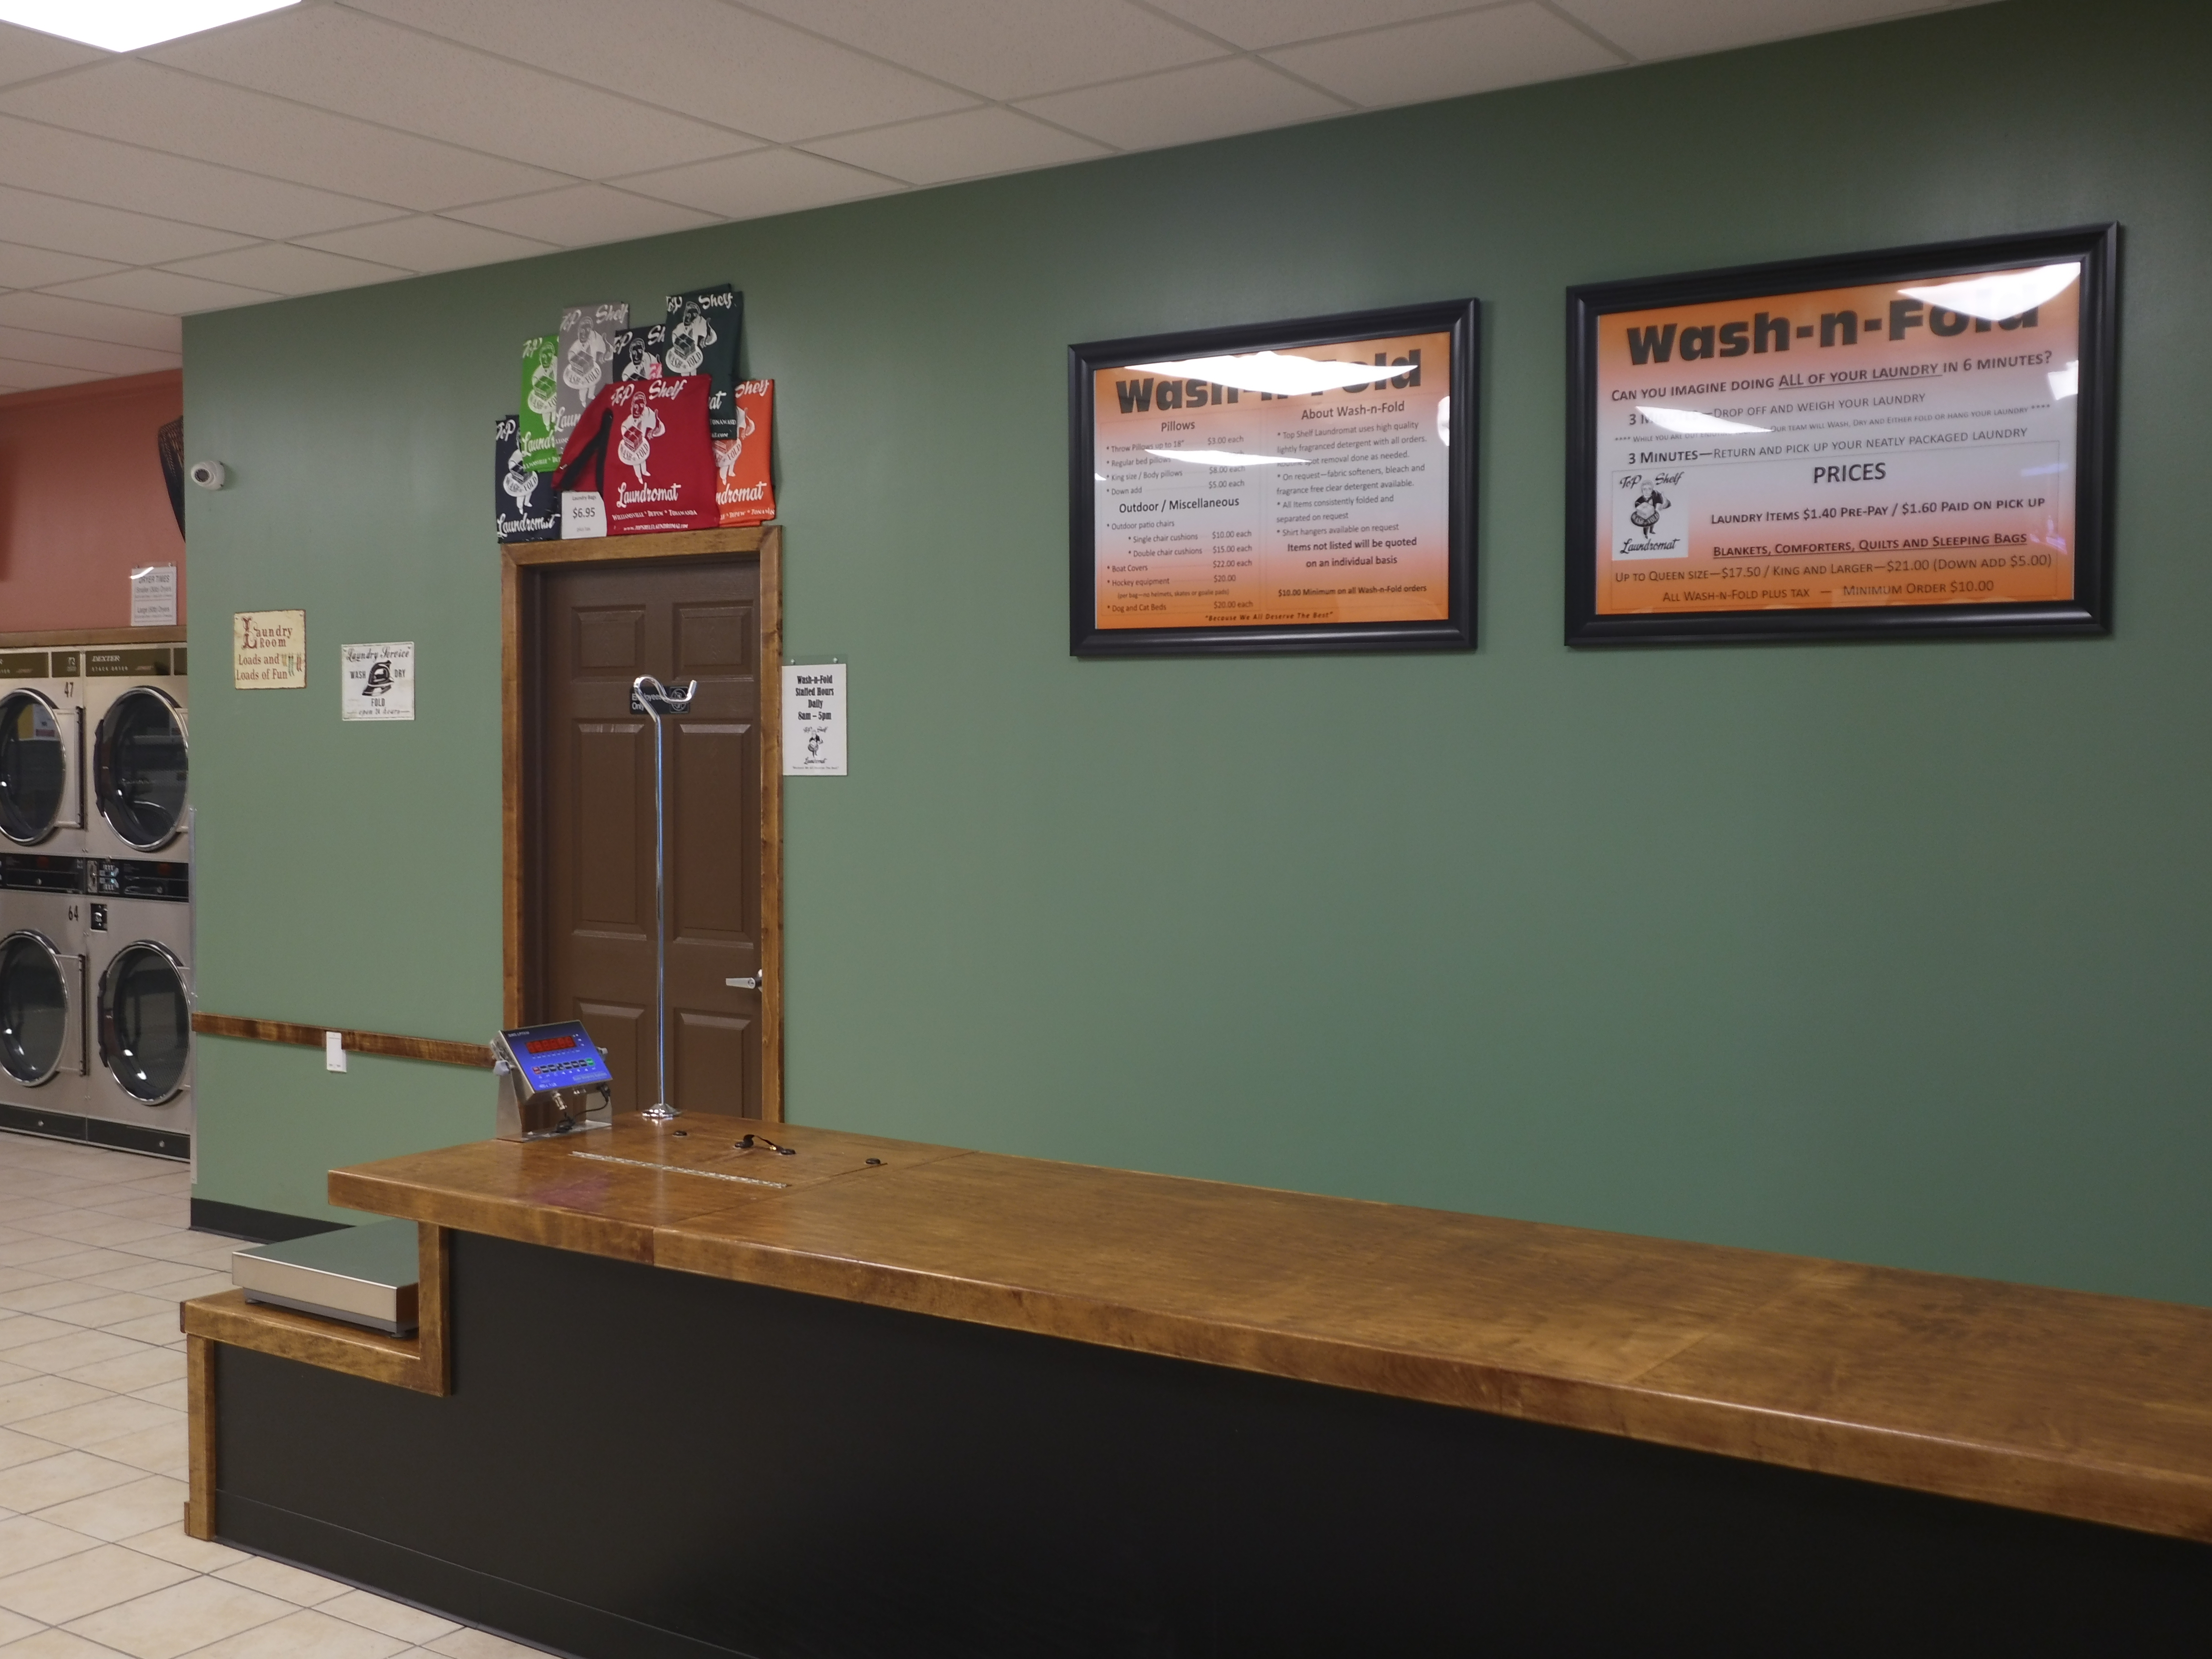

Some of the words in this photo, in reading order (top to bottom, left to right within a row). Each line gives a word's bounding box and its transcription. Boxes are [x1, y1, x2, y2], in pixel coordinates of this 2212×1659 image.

[698, 292, 733, 310] Shelf
[1612, 390, 1637, 402] CAN
[1641, 387, 1667, 399] YOU
[1671, 382, 1727, 397] IMAGINE
[1732, 378, 1775, 392] DOING
[1779, 374, 1805, 387] ALL
[1808, 373, 1825, 385] OF
[1830, 370, 1868, 382] YOUR
[1873, 364, 1940, 379] LAUNDRY
[1944, 362, 1958, 373] IN
[1964, 358, 1972, 372] 6
[1977, 351, 2052, 370] MINUTES?
[649, 379, 687, 401] Shelf
[1302, 408, 1334, 421] About
[1337, 401, 1405, 417] Wash-n-Fold
[1629, 413, 1636, 426] 3
[1748, 406, 1767, 417] OFF
[1770, 404, 1794, 415] AND
[1798, 401, 1835, 412] WEIGH
[1839, 398, 1870, 409] YOUR
[1874, 394, 1926, 407] LAUNDRY
[1161, 421, 1196, 432] Pillows
[1283, 432, 1296, 440] Top
[1297, 429, 1314, 439] Shelf
[1315, 427, 1357, 437] Laundromat
[1377, 423, 1393, 433] high
[1394, 421, 1419, 432] quality
[1132, 443, 1154, 453] Pillows
[1208, 436, 1227, 446] $3.00
[1228, 435, 1244, 444] each
[1629, 452, 1637, 465] 3
[1760, 446, 1783, 456] AND
[1787, 444, 1810, 454] PICK
[1814, 442, 1829, 452] UP
[1832, 440, 1862, 451] YOUR
[1867, 437, 1905, 448] NEATLY
[1910, 432, 1969, 445] PACKAGED
[1973, 428, 2028, 441] LAUNDRY
[1655, 472, 1685, 486] Shelf
[1814, 463, 1887, 484] PRICES
[616, 482, 681, 508] Laundromat
[573, 507, 596, 519] $6.95
[1119, 502, 1159, 514] Outdoor
[1170, 498, 1240, 510] Miscellaneous
[1712, 514, 1763, 525] LAUNDRY
[1767, 511, 1800, 522] ITEMS
[1804, 508, 1837, 522] $1.40
[1841, 506, 1889, 518] PRE-PAY
[1903, 502, 1938, 516] $1.60
[1941, 502, 1970, 513] PAID
[1974, 501, 1992, 511] ON
[1997, 499, 2024, 509] PICK
[2029, 498, 2046, 508] UP
[497, 513, 561, 539] Laundromat
[1212, 531, 1235, 540] $10.00
[1236, 530, 1252, 538] each
[1288, 544, 1312, 553] Items
[1313, 543, 1328, 551] not
[1330, 540, 1352, 550] listed
[1355, 539, 1370, 549] will
[1372, 539, 1383, 548] be
[1385, 537, 1418, 549] quoted
[1620, 538, 1680, 554] Laundromat
[1713, 546, 1771, 557] BLANKETS,
[1775, 541, 1855, 555] COMFORTERS,
[1859, 539, 1899, 551] QUILTS
[1904, 538, 1929, 548] AND
[1933, 535, 1990, 547] SLEEPING
[1994, 533, 2027, 544] BAGS
[1112, 565, 1126, 573] Boat
[1127, 564, 1149, 573] Covers
[1332, 557, 1374, 567] individual
[1376, 555, 1398, 565] basis
[1615, 572, 1630, 583] UP
[1633, 573, 1646, 583] TO
[1649, 571, 1685, 582] QUEEN
[1773, 566, 1800, 577] KING
[1804, 565, 1827, 576] AND
[1934, 559, 1977, 573] (DOWN
[1981, 558, 2006, 568] ADD
[2011, 554, 2052, 568] $5.00)
[1112, 579, 1135, 588] Hockey
[1136, 578, 1170, 587] equipment
[1843, 585, 1903, 596] MINIMUM
[1906, 583, 1947, 594] ORDER
[1951, 580, 1995, 594] $10.00
[1663, 592, 1681, 603] ALL
[1684, 589, 1759, 602] WASH-N-FOLD
[1762, 589, 1788, 599] PLUS
[1791, 589, 1810, 598] TAX
[241, 616, 293, 650] Laundry
[238, 654, 262, 666] Loads
[263, 653, 280, 665] and
[346, 649, 378, 663] Laundry
[380, 646, 410, 659] Service
[236, 669, 260, 681] Loads
[261, 669, 270, 680] of
[272, 669, 288, 680] Fun
[350, 670, 367, 679] WASH
[394, 669, 406, 679] DRY
[797, 675, 833, 684] Wash-n-Fold
[64, 682, 74, 698] 47
[795, 687, 815, 696] Staffed
[817, 687, 834, 696] Hours
[371, 698, 386, 707] FOLD
[808, 699, 823, 709] Daily
[798, 711, 811, 720] 8am
[818, 711, 832, 721] 5pm
[68, 905, 79, 922] 64
